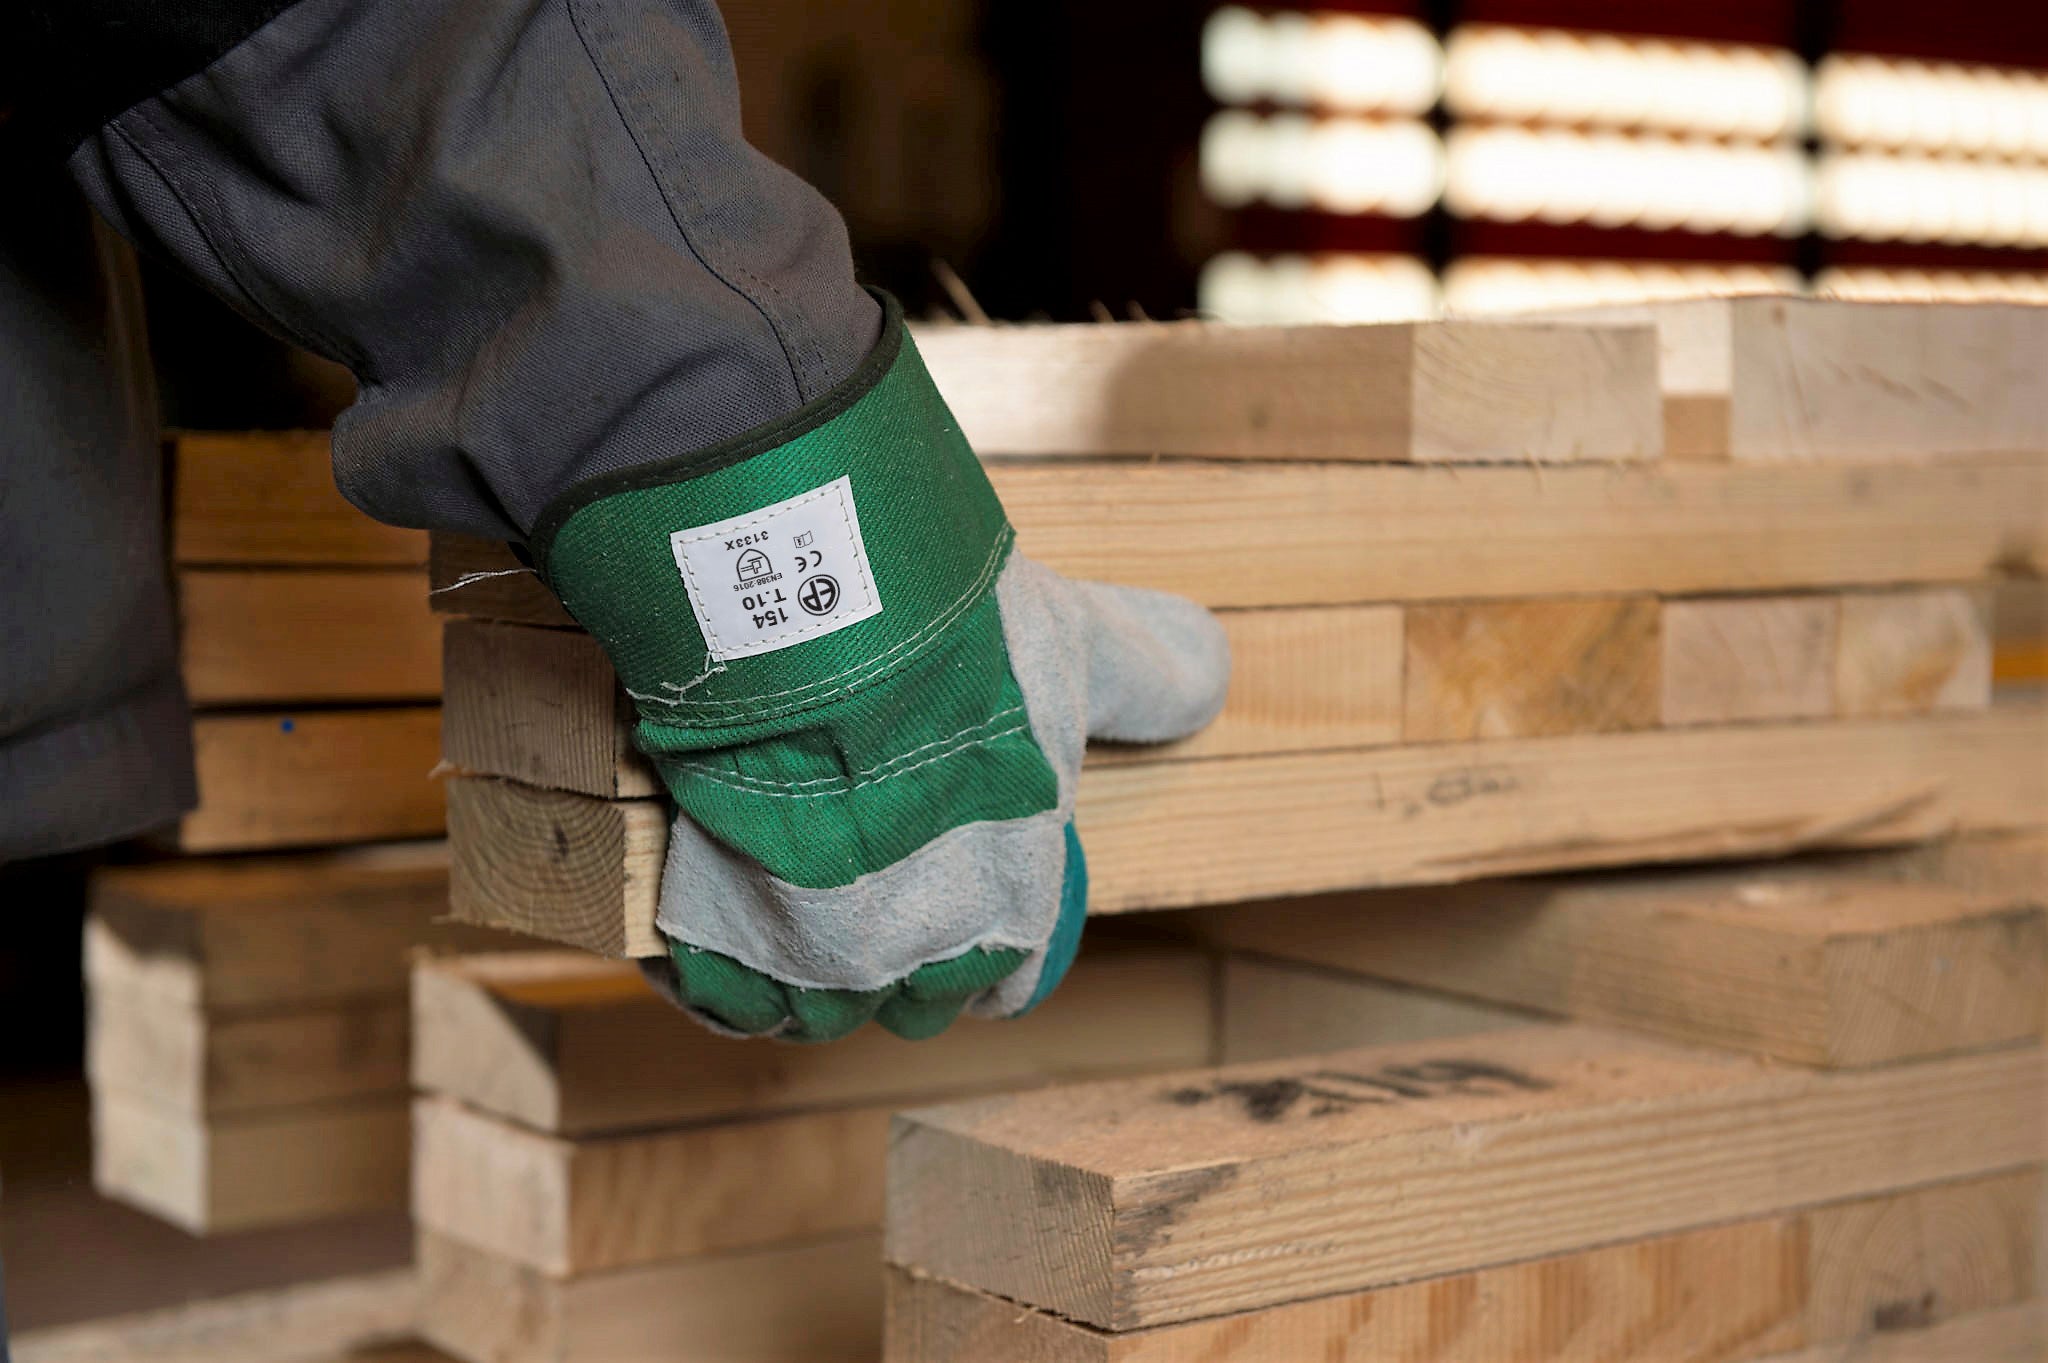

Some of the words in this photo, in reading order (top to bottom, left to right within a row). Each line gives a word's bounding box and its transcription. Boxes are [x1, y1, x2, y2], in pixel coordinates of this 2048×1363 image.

[724, 530, 769, 551] 3133X
[794, 550, 822, 573] CE
[742, 588, 787, 611] T.10
[752, 607, 789, 630] 154
